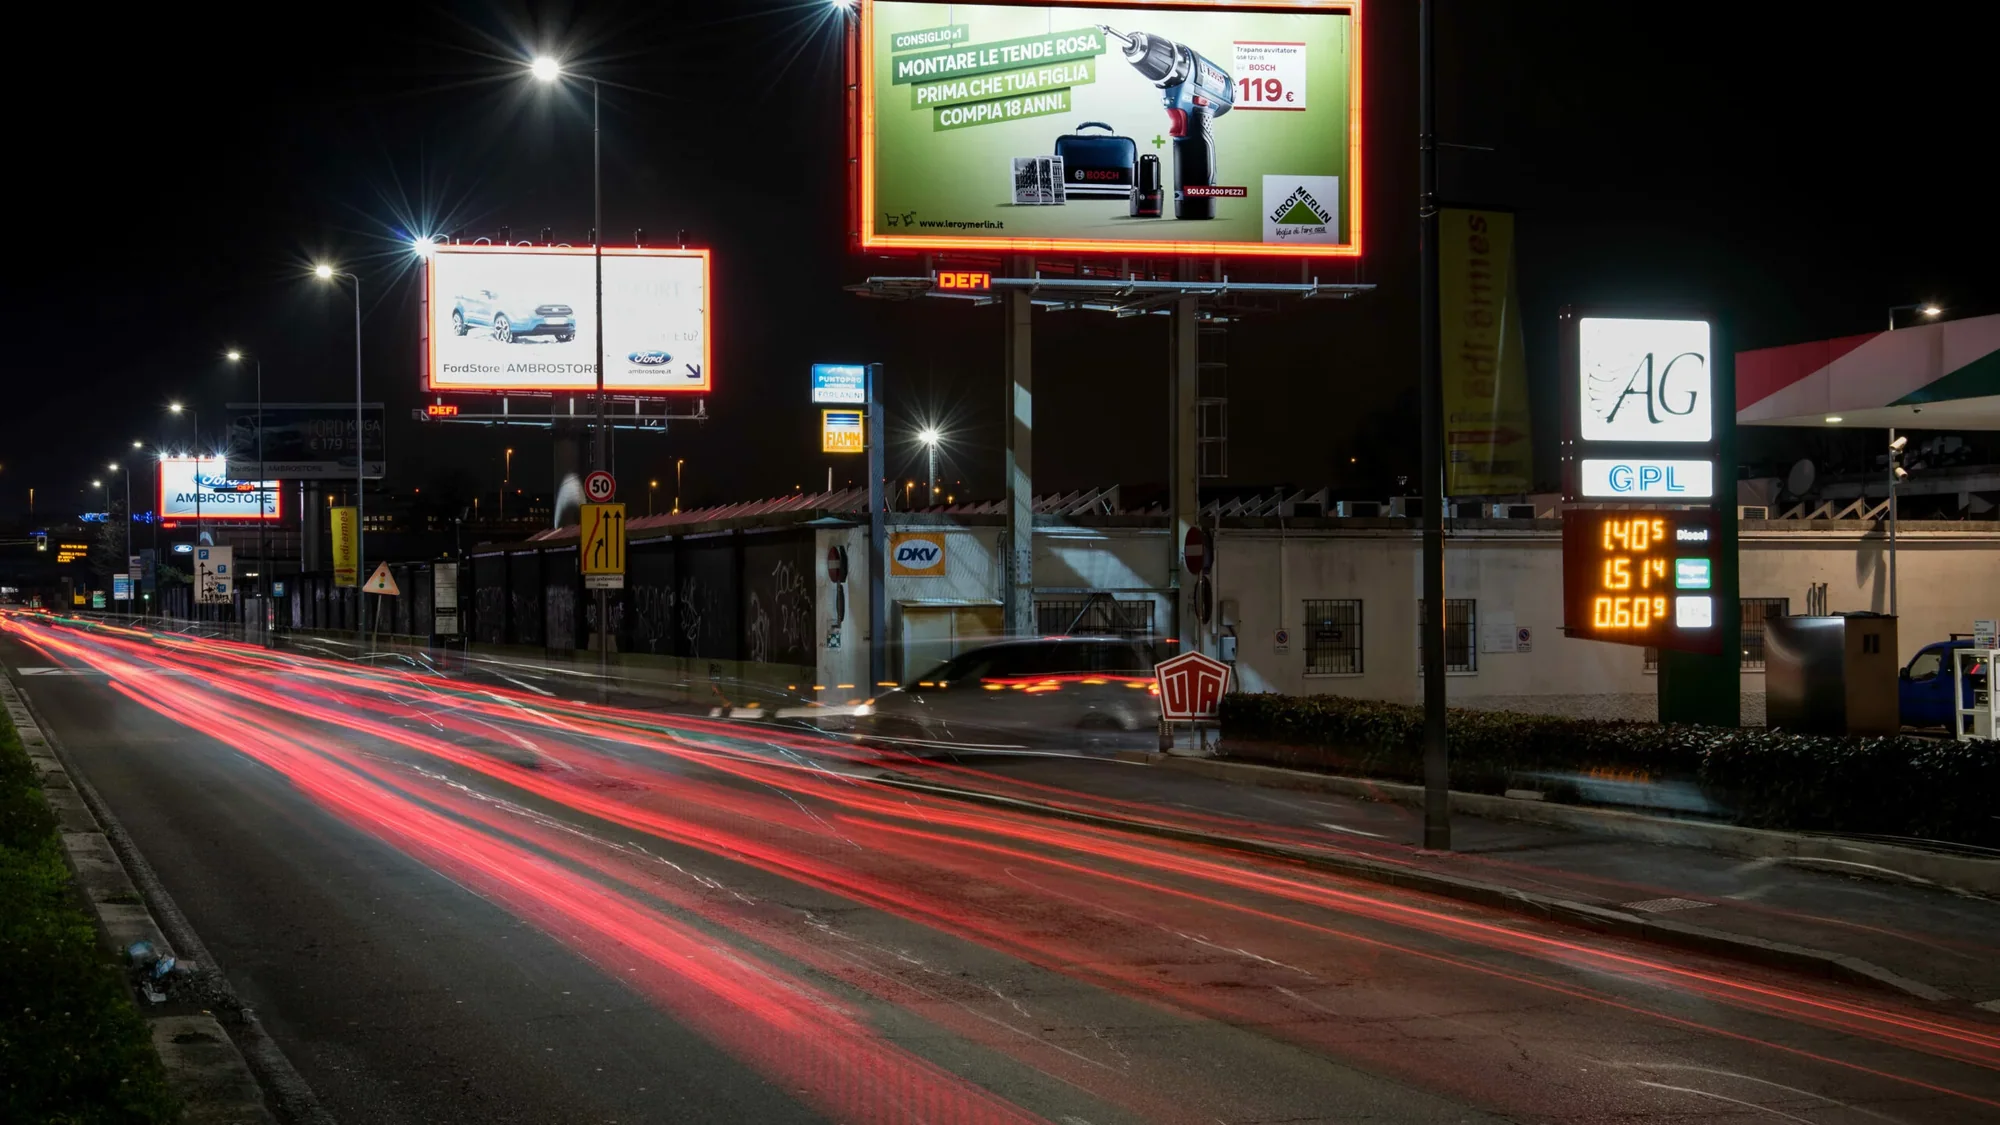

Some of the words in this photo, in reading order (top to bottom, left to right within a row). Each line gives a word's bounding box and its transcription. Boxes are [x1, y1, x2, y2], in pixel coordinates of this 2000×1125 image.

[896, 30, 951, 47] CONSIGLIO
[898, 57, 977, 78] MONTARE
[980, 50, 999, 66] LE
[1000, 42, 1054, 63] TENDE
[1056, 34, 1101, 56] ROSA.
[1236, 46, 1263, 54] Trapano
[917, 84, 968, 104] PRIMA
[970, 77, 1003, 96] CHE
[1004, 71, 1037, 90] TUA
[1039, 64, 1089, 86] FIGLIA
[1239, 78, 1283, 102] 119
[1286, 91, 1294, 102] €
[940, 106, 1003, 126] COMPIA
[1004, 101, 1021, 117] 18
[1023, 94, 1066, 115] ANNI.
[1086, 171, 1119, 180] BOSCH
[1205, 188, 1223, 196] 2.000
[1269, 192, 1299, 223] LEROY
[1295, 185, 1332, 224] MERLIN
[920, 220, 1004, 230] www.leroymerlin.it
[939, 272, 989, 288] DEFI
[443, 364, 500, 373] FordStore
[506, 363, 600, 375] AMBROSTORE
[818, 376, 862, 384] PUNTOPRO
[818, 391, 863, 399] FORLANINI
[428, 406, 457, 416] DEFI
[309, 420, 344, 437] FORD
[322, 438, 343, 450] 179
[826, 431, 861, 446] FIAMM
[1608, 464, 1686, 492] GPL
[592, 479, 610, 494] 50
[175, 493, 272, 504] AMBROSTORE
[1676, 529, 1708, 541] Diesel
[897, 547, 939, 562] DKV
